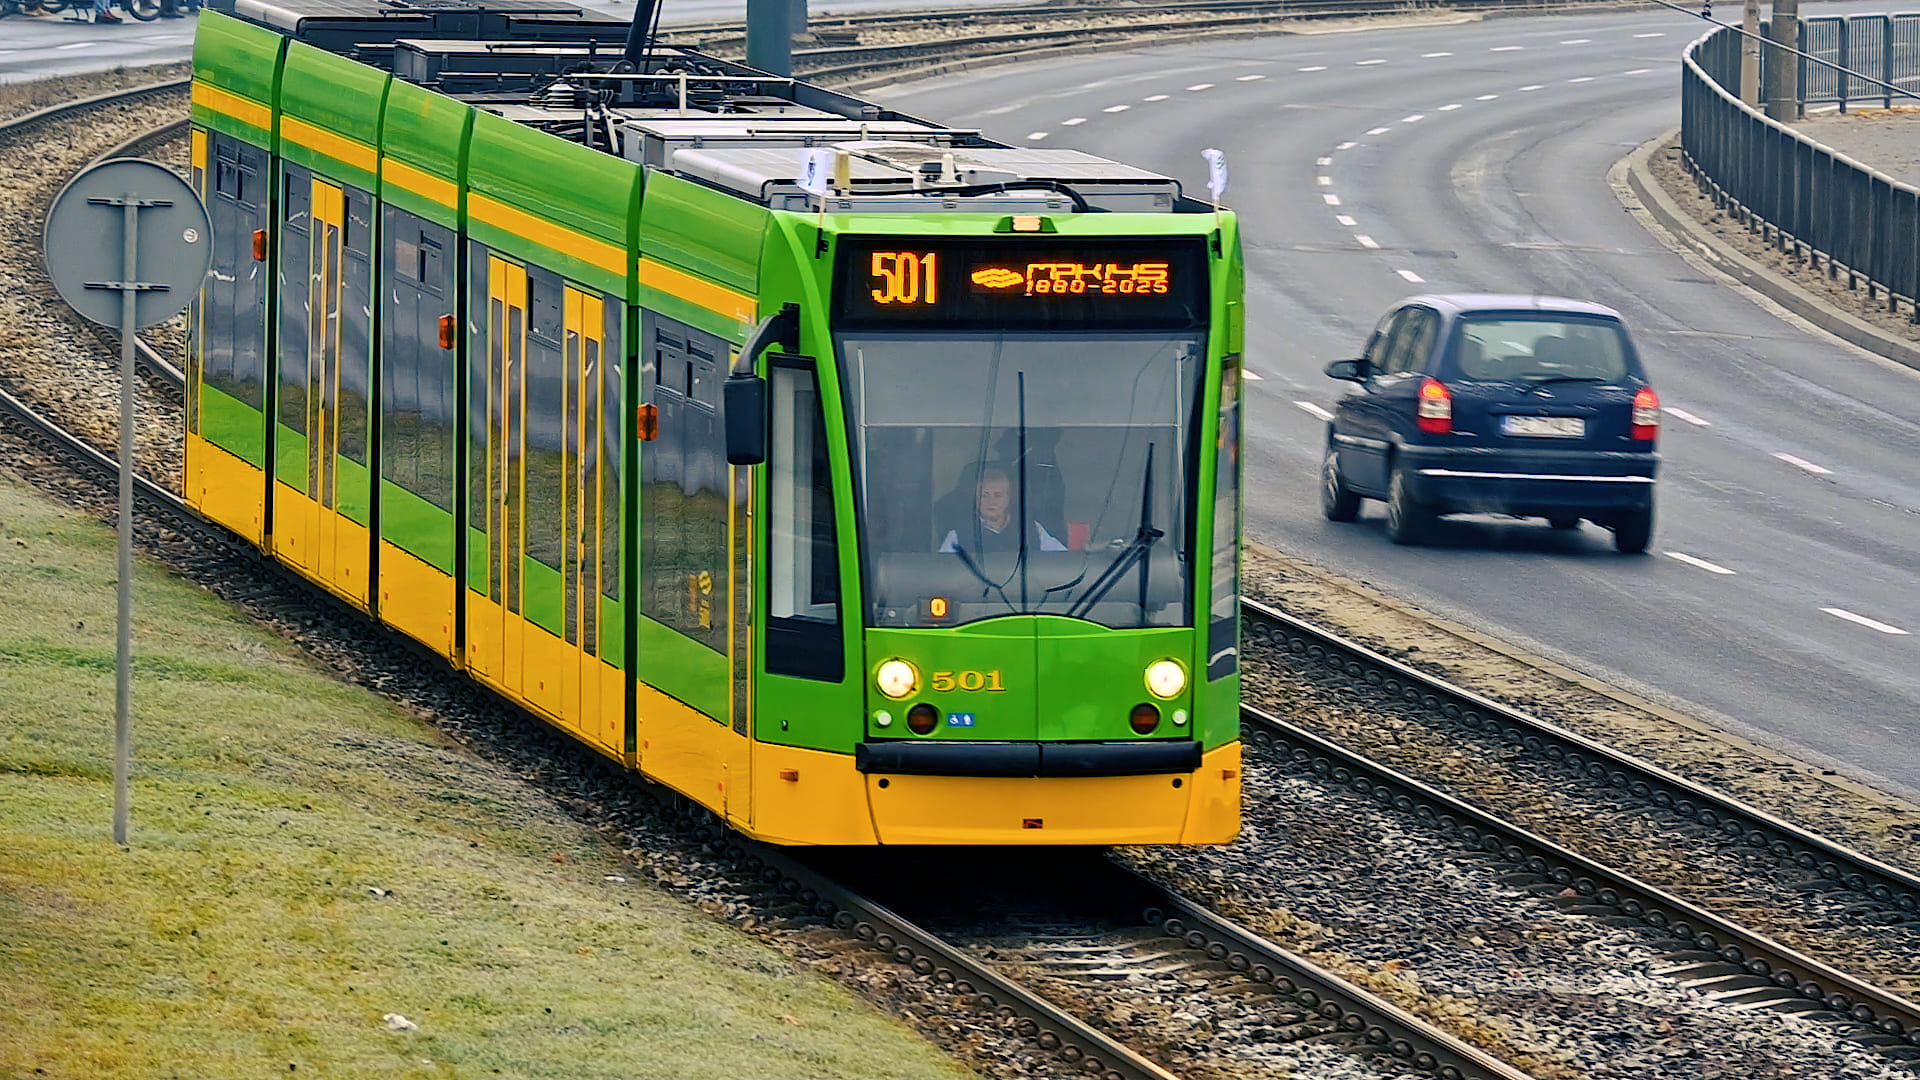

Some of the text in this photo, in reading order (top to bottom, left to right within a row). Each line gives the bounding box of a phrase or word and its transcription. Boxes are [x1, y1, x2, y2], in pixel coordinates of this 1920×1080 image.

[871, 251, 936, 304] 501
[1026, 279, 1168, 294] 1880-2025
[932, 670, 1005, 692] 501
